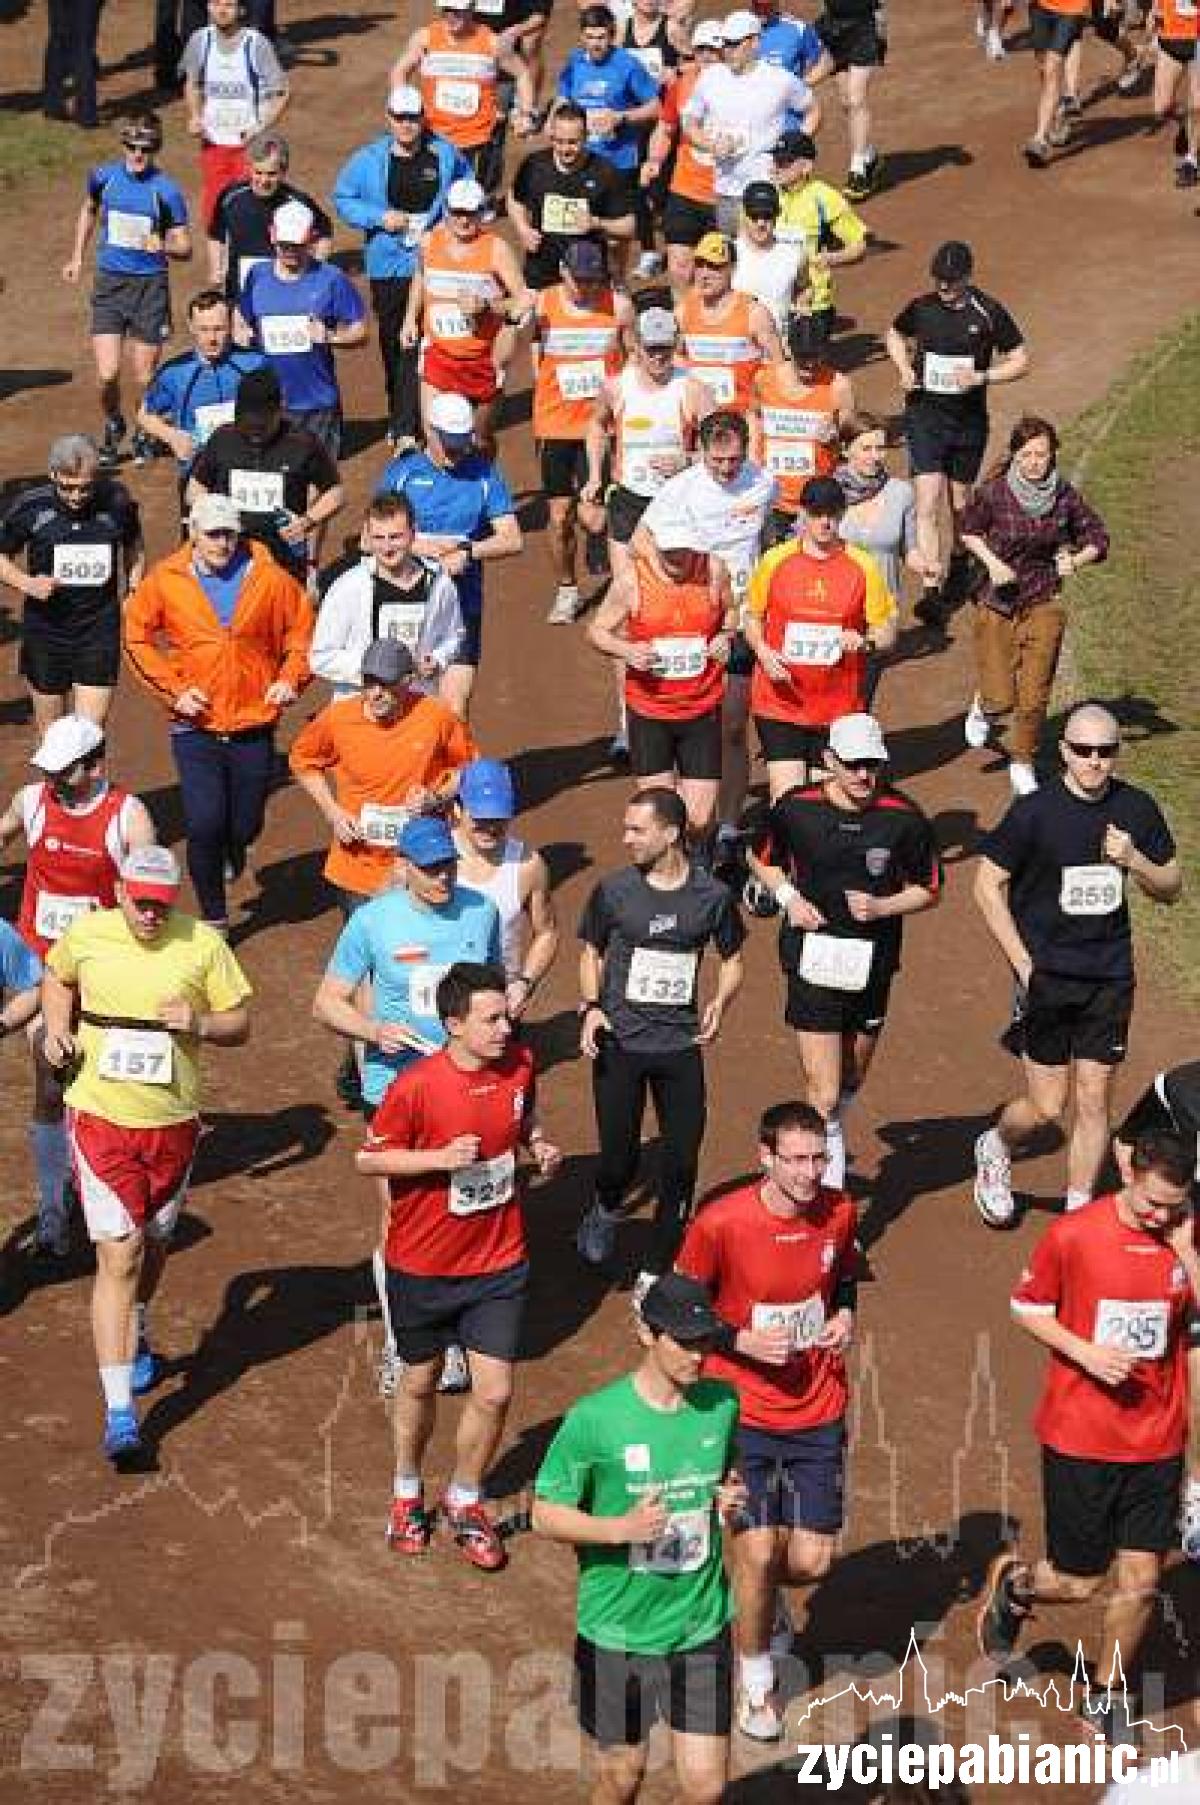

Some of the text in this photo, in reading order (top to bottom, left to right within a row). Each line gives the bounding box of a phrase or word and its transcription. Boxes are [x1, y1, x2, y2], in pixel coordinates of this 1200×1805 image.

[60, 562, 107, 579] 502
[787, 639, 839, 659] 377
[1067, 884, 1116, 907] 259
[637, 975, 689, 999] 132
[105, 1049, 166, 1076] 157
